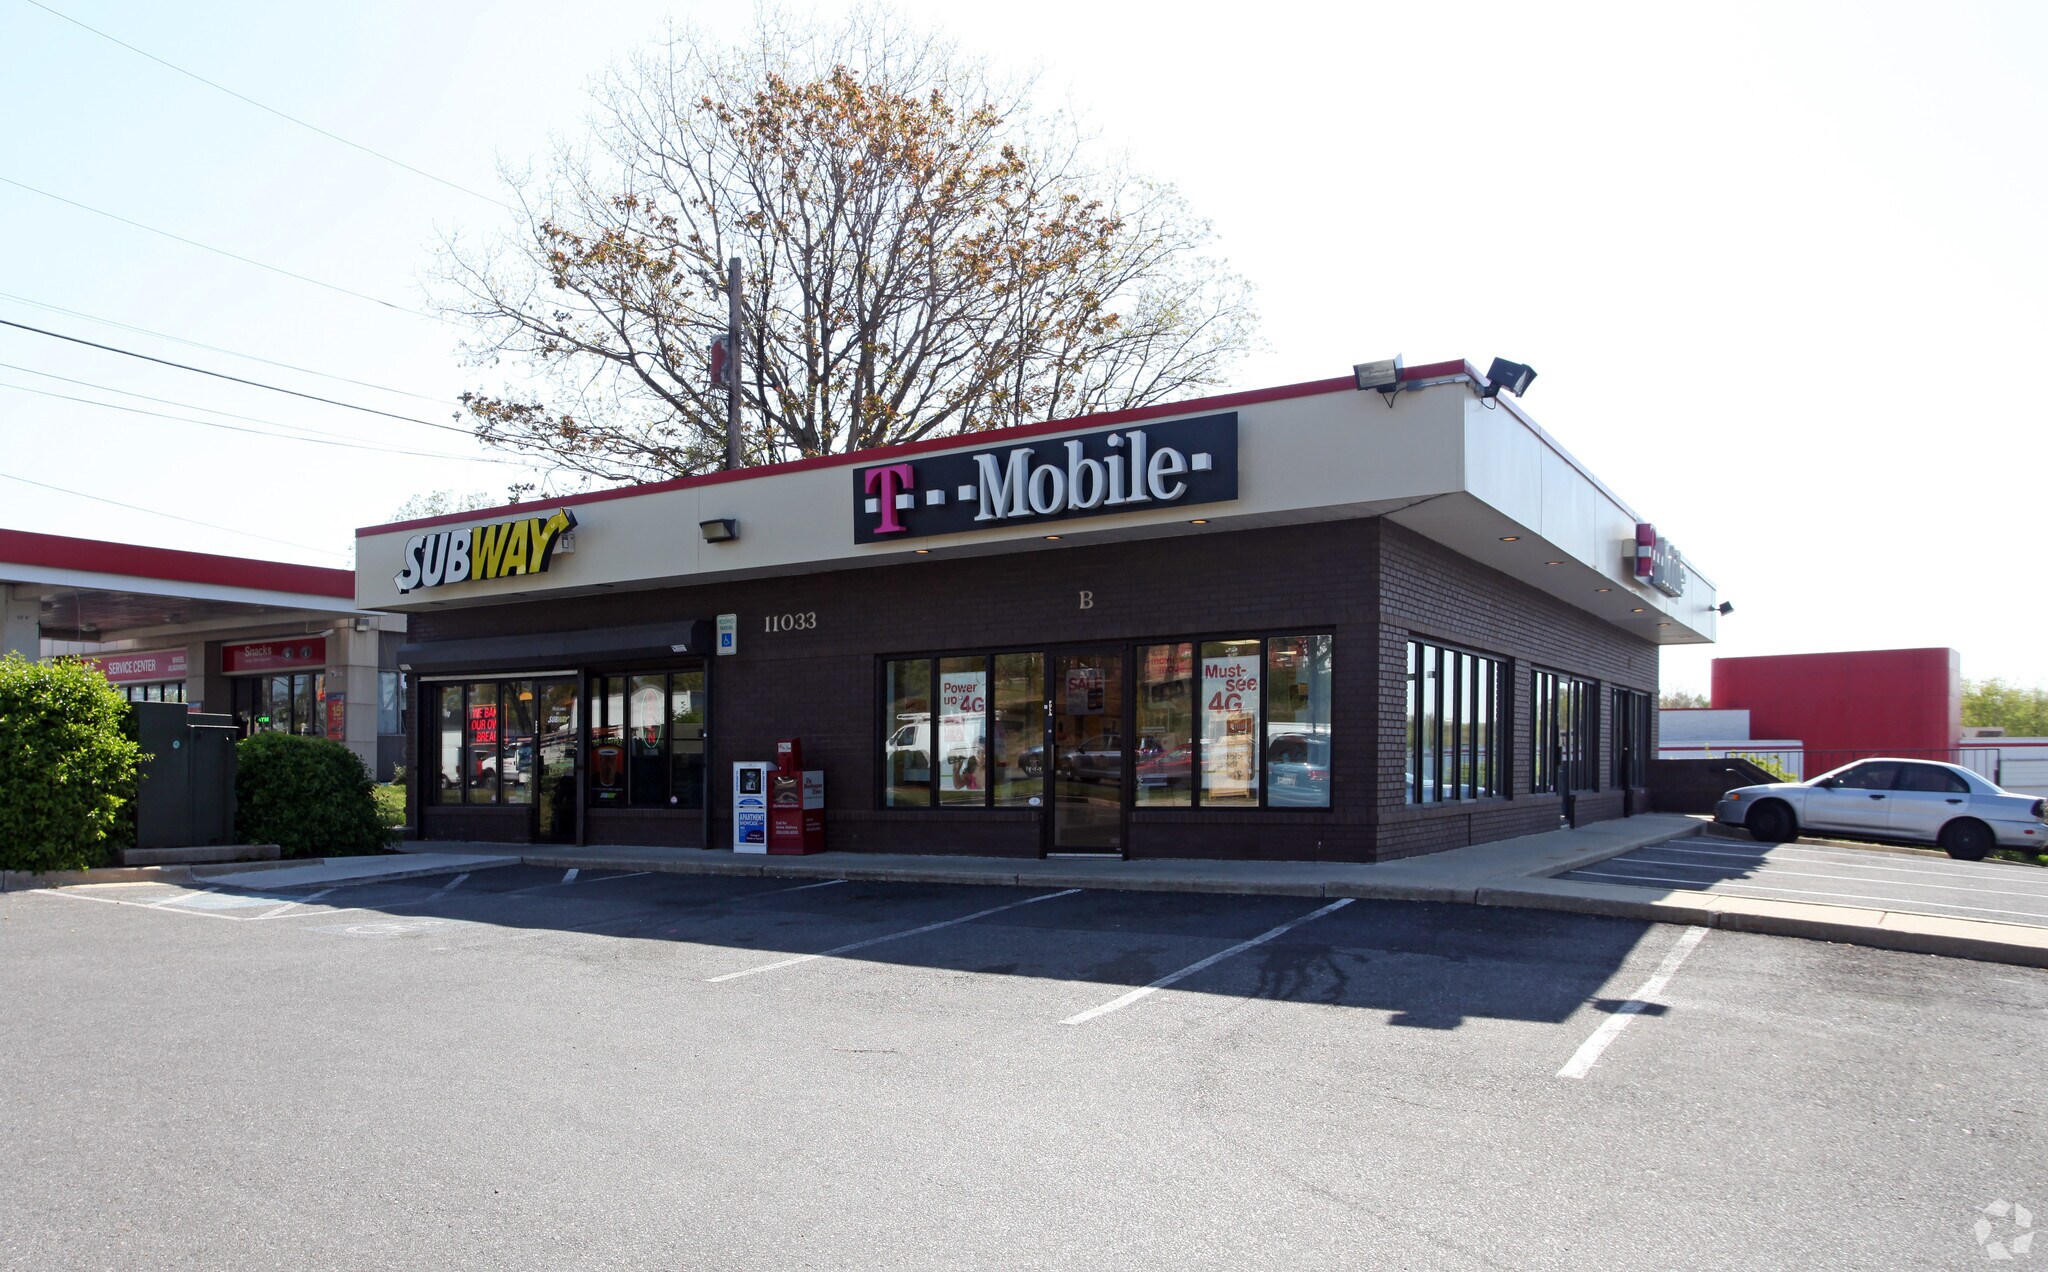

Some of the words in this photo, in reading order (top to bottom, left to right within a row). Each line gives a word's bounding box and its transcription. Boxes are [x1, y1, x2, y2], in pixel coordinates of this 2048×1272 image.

[393, 507, 572, 594] SUBWAY
[1079, 590, 1094, 610] B
[764, 611, 817, 633] 11033
[244, 645, 272, 657] Snacks
[108, 661, 133, 675] SERVICE
[133, 659, 156, 673] CENTER
[1205, 663, 1247, 679] Must-
[943, 682, 978, 694] Power
[1068, 677, 1103, 691] SALE
[1225, 677, 1258, 692] see
[943, 696, 958, 706] up
[960, 695, 985, 713] 4G
[1208, 691, 1243, 714] 4G
[472, 706, 483, 719] WE
[547, 715, 570, 724] SUBWAY
[471, 720, 486, 731] OUR
[739, 813, 764, 821] APARTMENT
